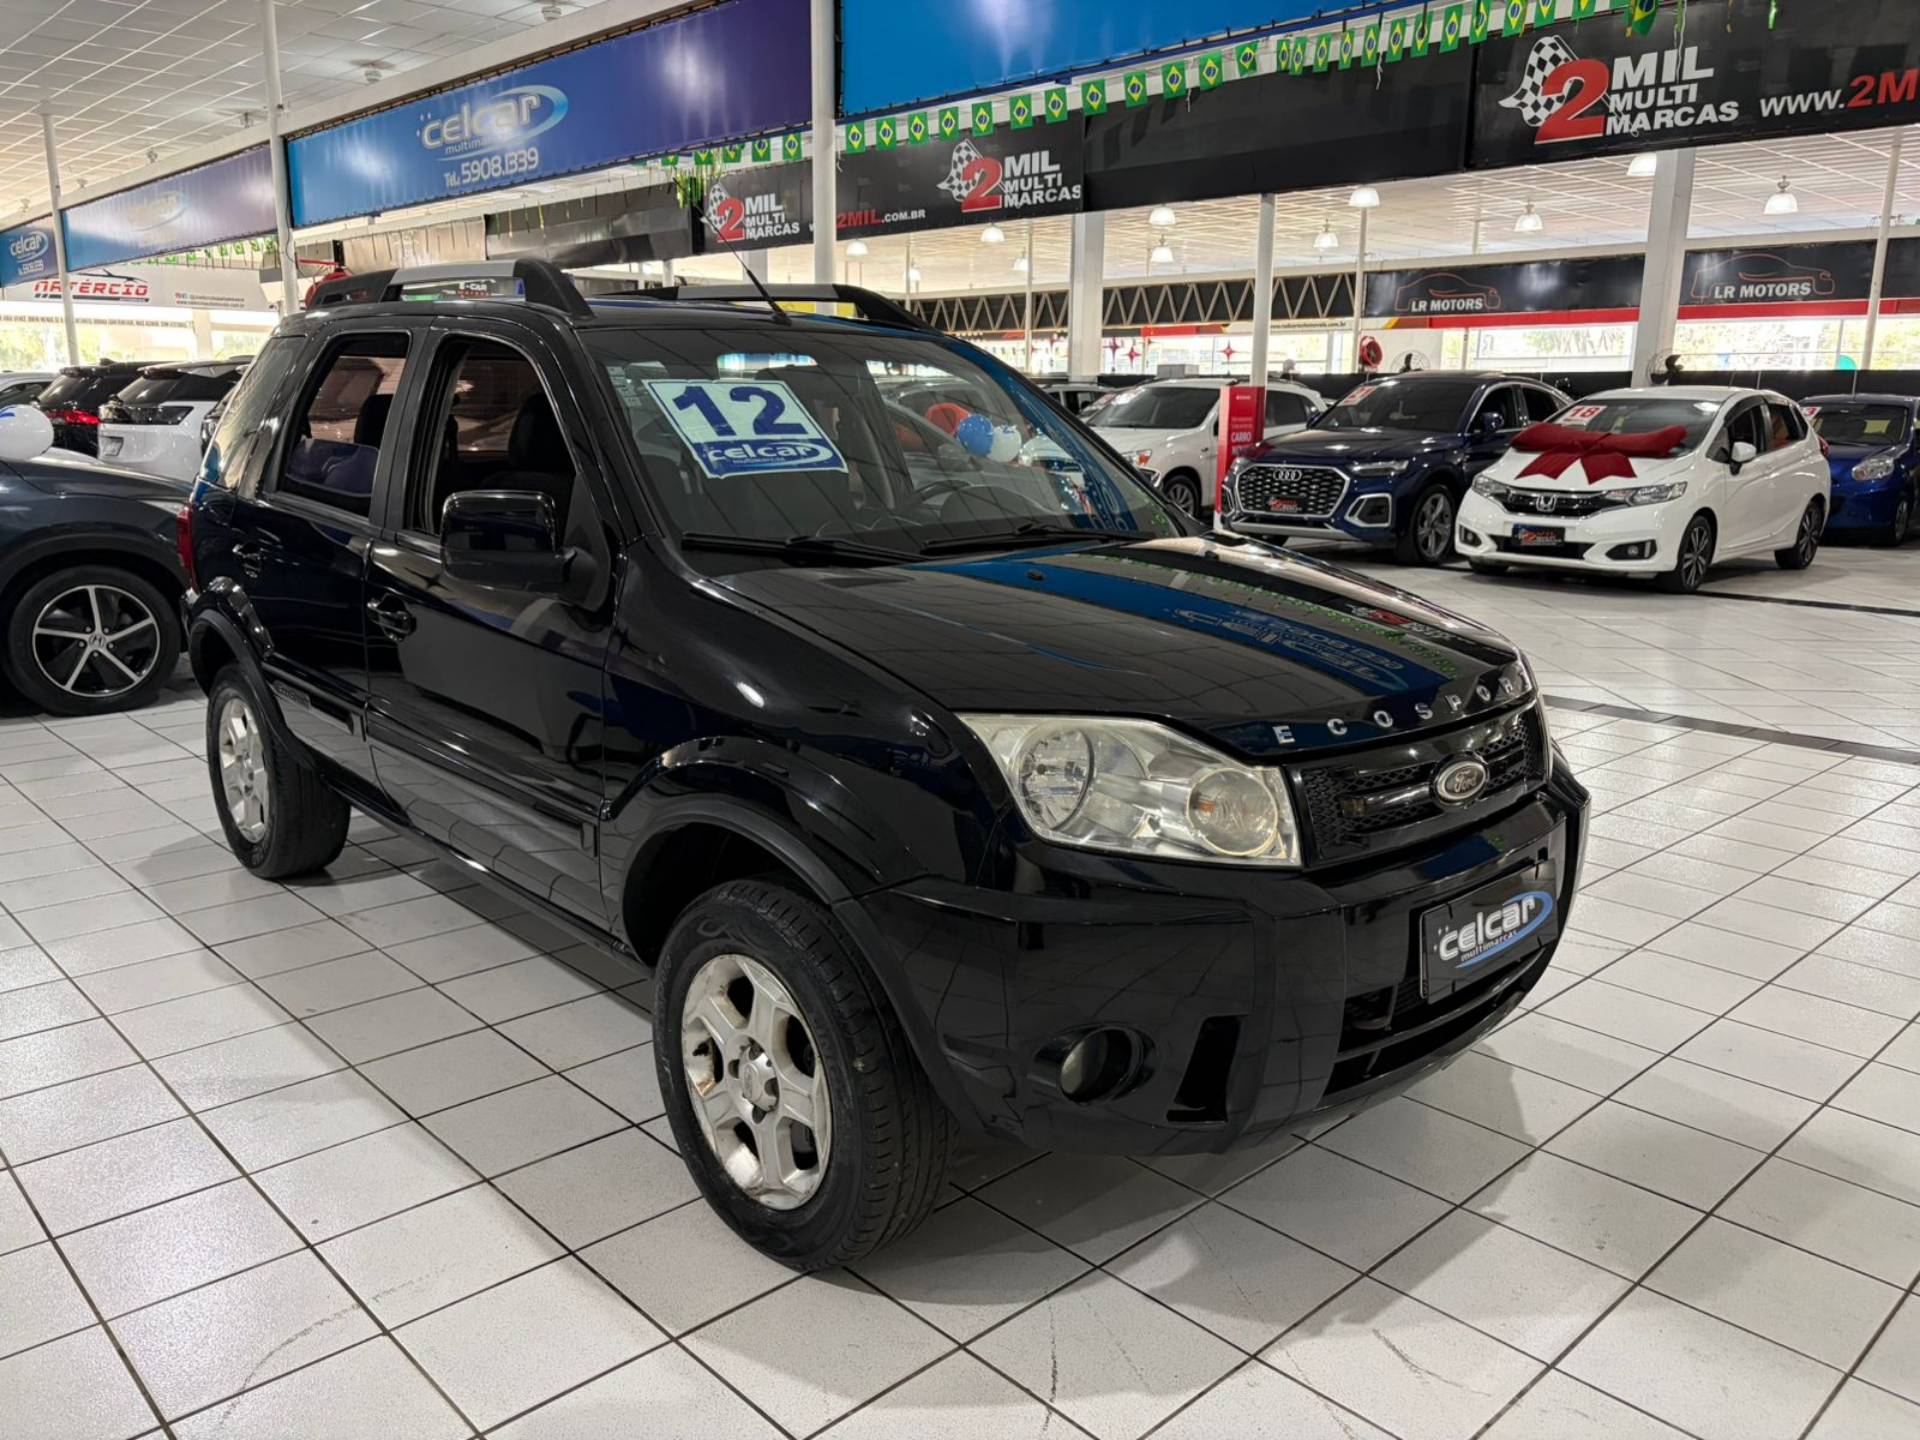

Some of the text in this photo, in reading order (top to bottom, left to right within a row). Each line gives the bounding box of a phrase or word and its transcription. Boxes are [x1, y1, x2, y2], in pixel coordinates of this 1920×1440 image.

[1534, 46, 1715, 145] 2 MIL
[1607, 83, 1699, 113] MULTI
[421, 93, 542, 150] celcar
[1605, 101, 1740, 138] MARCAS
[461, 147, 540, 184] 5908.1339
[961, 150, 1061, 213] 2 MIL
[1004, 172, 1063, 194] MULTI
[1004, 184, 1081, 209] MARCAS
[717, 193, 784, 244] 2 MIL
[745, 211, 786, 228] MULTI
[745, 222, 800, 240] MARCAS
[1411, 297, 1484, 313] LR MOTORS
[1714, 282, 1812, 299] LR MOTORS
[673, 385, 809, 437] 12
[707, 442, 812, 463] celcar
[1452, 770, 1481, 794] Ford
[1438, 894, 1536, 961] celcar
